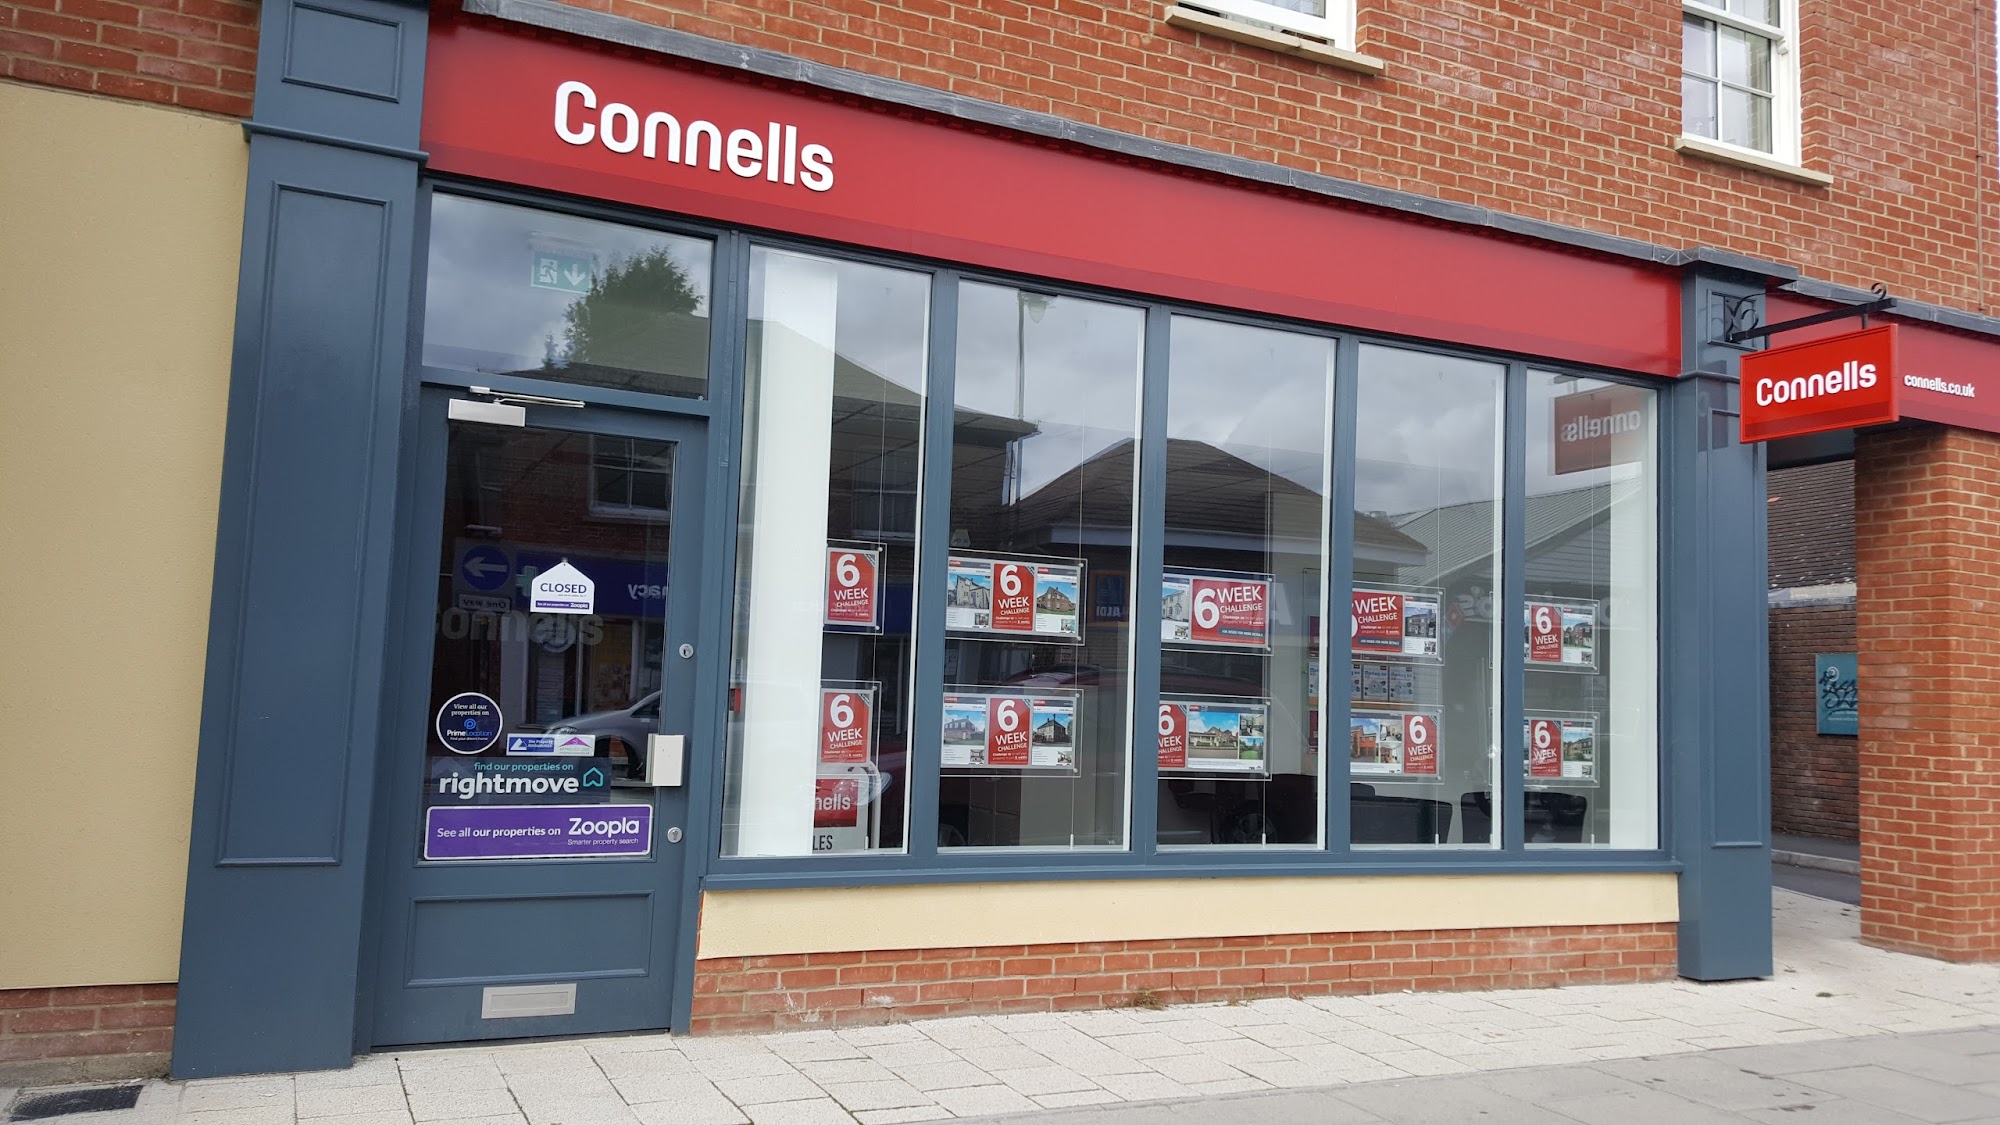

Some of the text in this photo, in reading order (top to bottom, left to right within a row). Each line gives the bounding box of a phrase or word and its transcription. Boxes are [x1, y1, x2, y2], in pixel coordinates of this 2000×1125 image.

[554, 80, 834, 192] Connells
[1756, 360, 1876, 407] Connells
[1904, 374, 1975, 398] connells.co.uk
[836, 553, 860, 588] 6
[540, 582, 587, 594] CLOSED
[1000, 564, 1022, 597] 6
[834, 587, 869, 601] WEEK
[1216, 585, 1263, 604] WEEK
[836, 599, 869, 608] CHALLENGE
[998, 596, 1030, 609] WEEK
[1194, 588, 1220, 629] 6
[1220, 603, 1263, 613] CHALLENGE
[1354, 595, 1398, 614] WEEK
[1000, 607, 1030, 616] CHALLENGE
[1358, 612, 1398, 624] CHALLENGE
[1535, 606, 1552, 634] 6
[1534, 634, 1558, 645] WEEK
[830, 693, 854, 729] 6
[997, 699, 1019, 732] 6
[1159, 704, 1175, 736] 6
[827, 727, 863, 742] WEEK
[1409, 715, 1427, 744] 6
[1534, 720, 1551, 749] 6
[830, 740, 864, 750] CHALLENGE
[994, 731, 1027, 746] WEEK
[997, 743, 1027, 752] CHALLENGE
[1158, 746, 1182, 754] HALLENGE
[1408, 744, 1434, 756] WEEK
[1533, 748, 1557, 760] WEEK
[1410, 754, 1434, 762] CHALLENGE
[474, 762, 574, 773] find our properties on
[439, 772, 579, 800] rightmove
[437, 817, 640, 838] See all our properties on Zoopla
[567, 837, 639, 846] Smarter property search
[812, 834, 833, 851] LES
